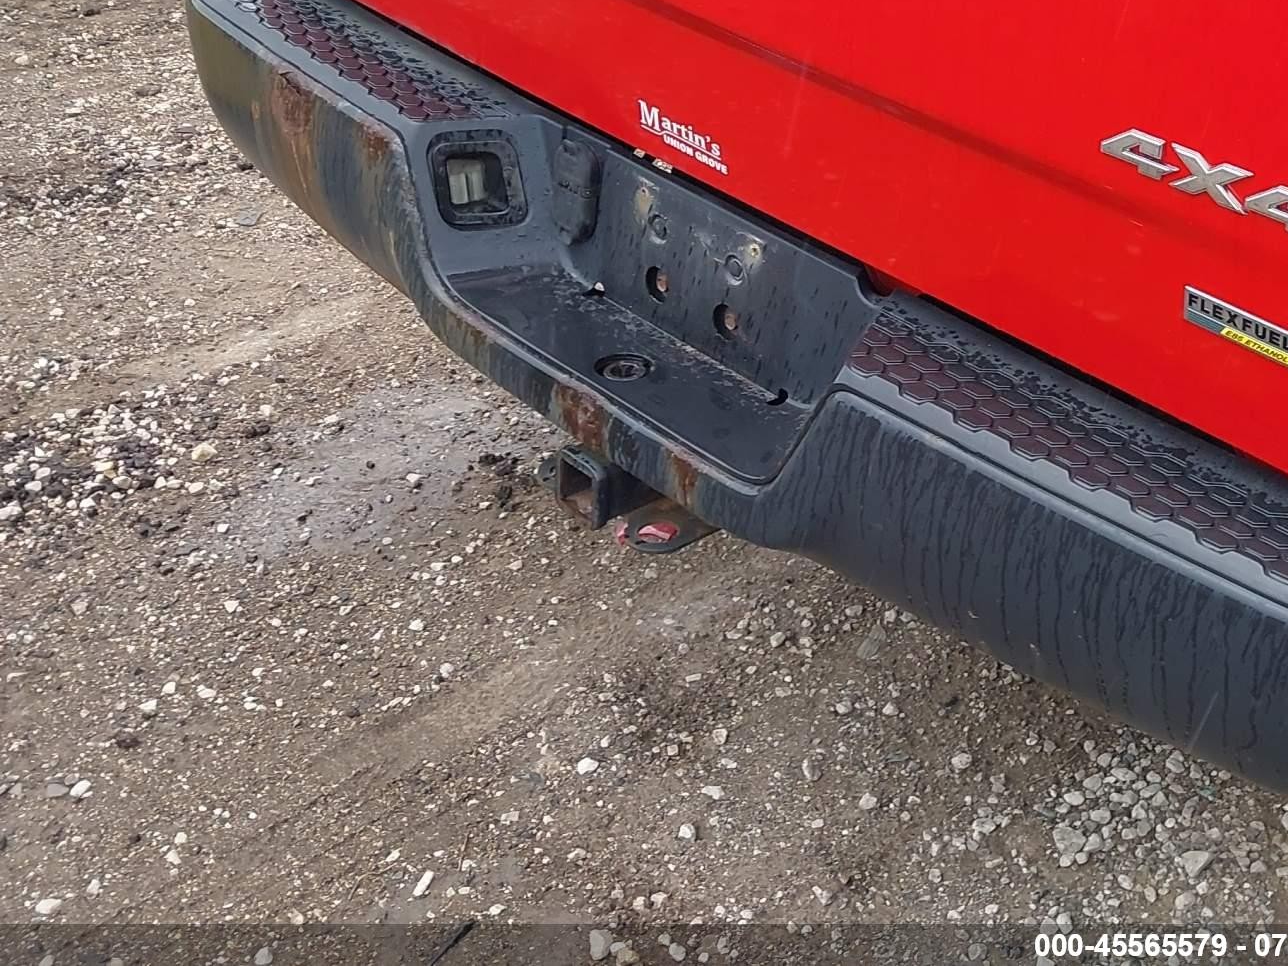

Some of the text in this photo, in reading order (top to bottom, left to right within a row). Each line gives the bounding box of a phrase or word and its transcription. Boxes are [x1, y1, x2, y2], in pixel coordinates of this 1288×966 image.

[638, 99, 721, 156] Martin's
[663, 134, 694, 157] UNION
[694, 150, 729, 175] GROVE
